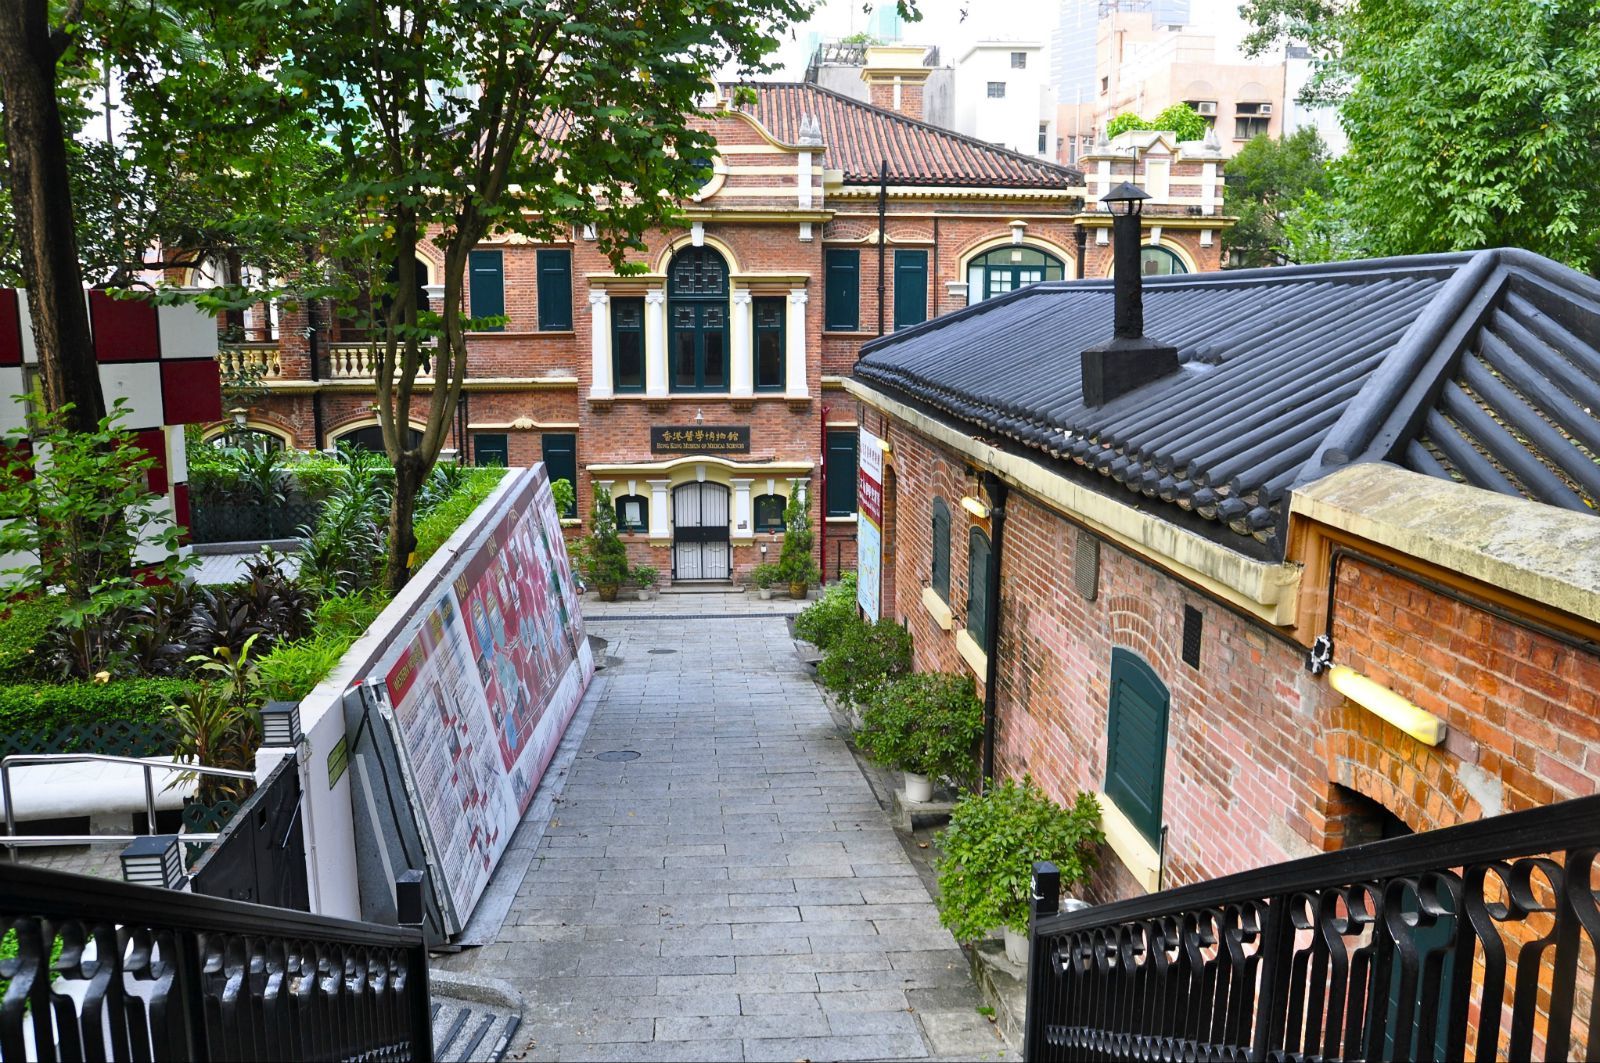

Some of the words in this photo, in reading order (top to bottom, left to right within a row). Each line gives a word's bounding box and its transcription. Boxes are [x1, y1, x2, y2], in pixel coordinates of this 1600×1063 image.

[662, 430, 739, 441] 香港醫學博物館
